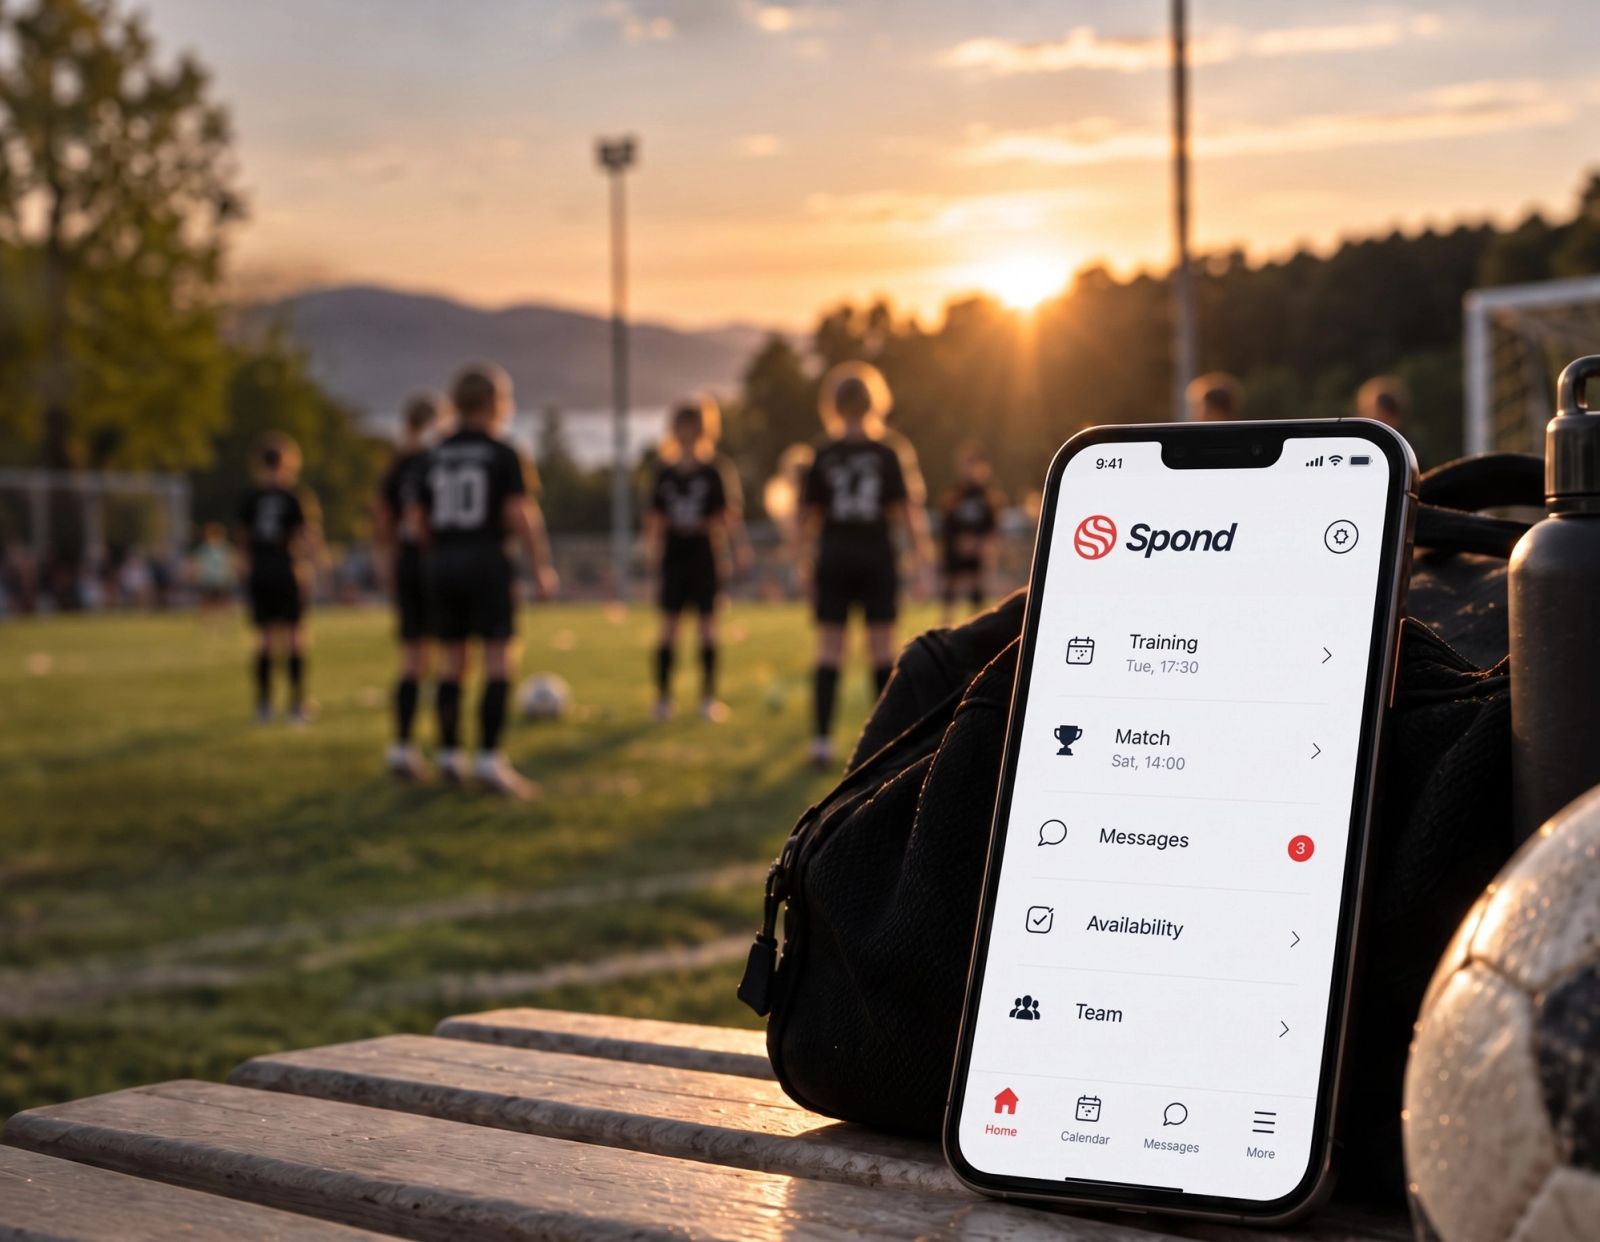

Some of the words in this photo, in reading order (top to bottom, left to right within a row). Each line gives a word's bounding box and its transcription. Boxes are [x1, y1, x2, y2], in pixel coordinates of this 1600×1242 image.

[1095, 457, 1123, 470] 9:41
[429, 466, 487, 527] 10
[1125, 522, 1239, 559] Spond
[1129, 633, 1199, 655] Training
[1126, 659, 1155, 676] Tue,
[1160, 660, 1199, 674] 17:30
[1115, 728, 1171, 746] Match
[1111, 753, 1138, 770] Sat,
[1145, 755, 1186, 771] 14:00
[1099, 827, 1190, 851] Messages
[1295, 842, 1306, 855] 3
[1086, 914, 1184, 941] Availability
[1075, 1002, 1123, 1023] Team
[985, 1124, 1018, 1137] Home
[1060, 1130, 1111, 1145] Calendar
[1143, 1138, 1200, 1155] Messages
[1246, 1146, 1276, 1160] More
